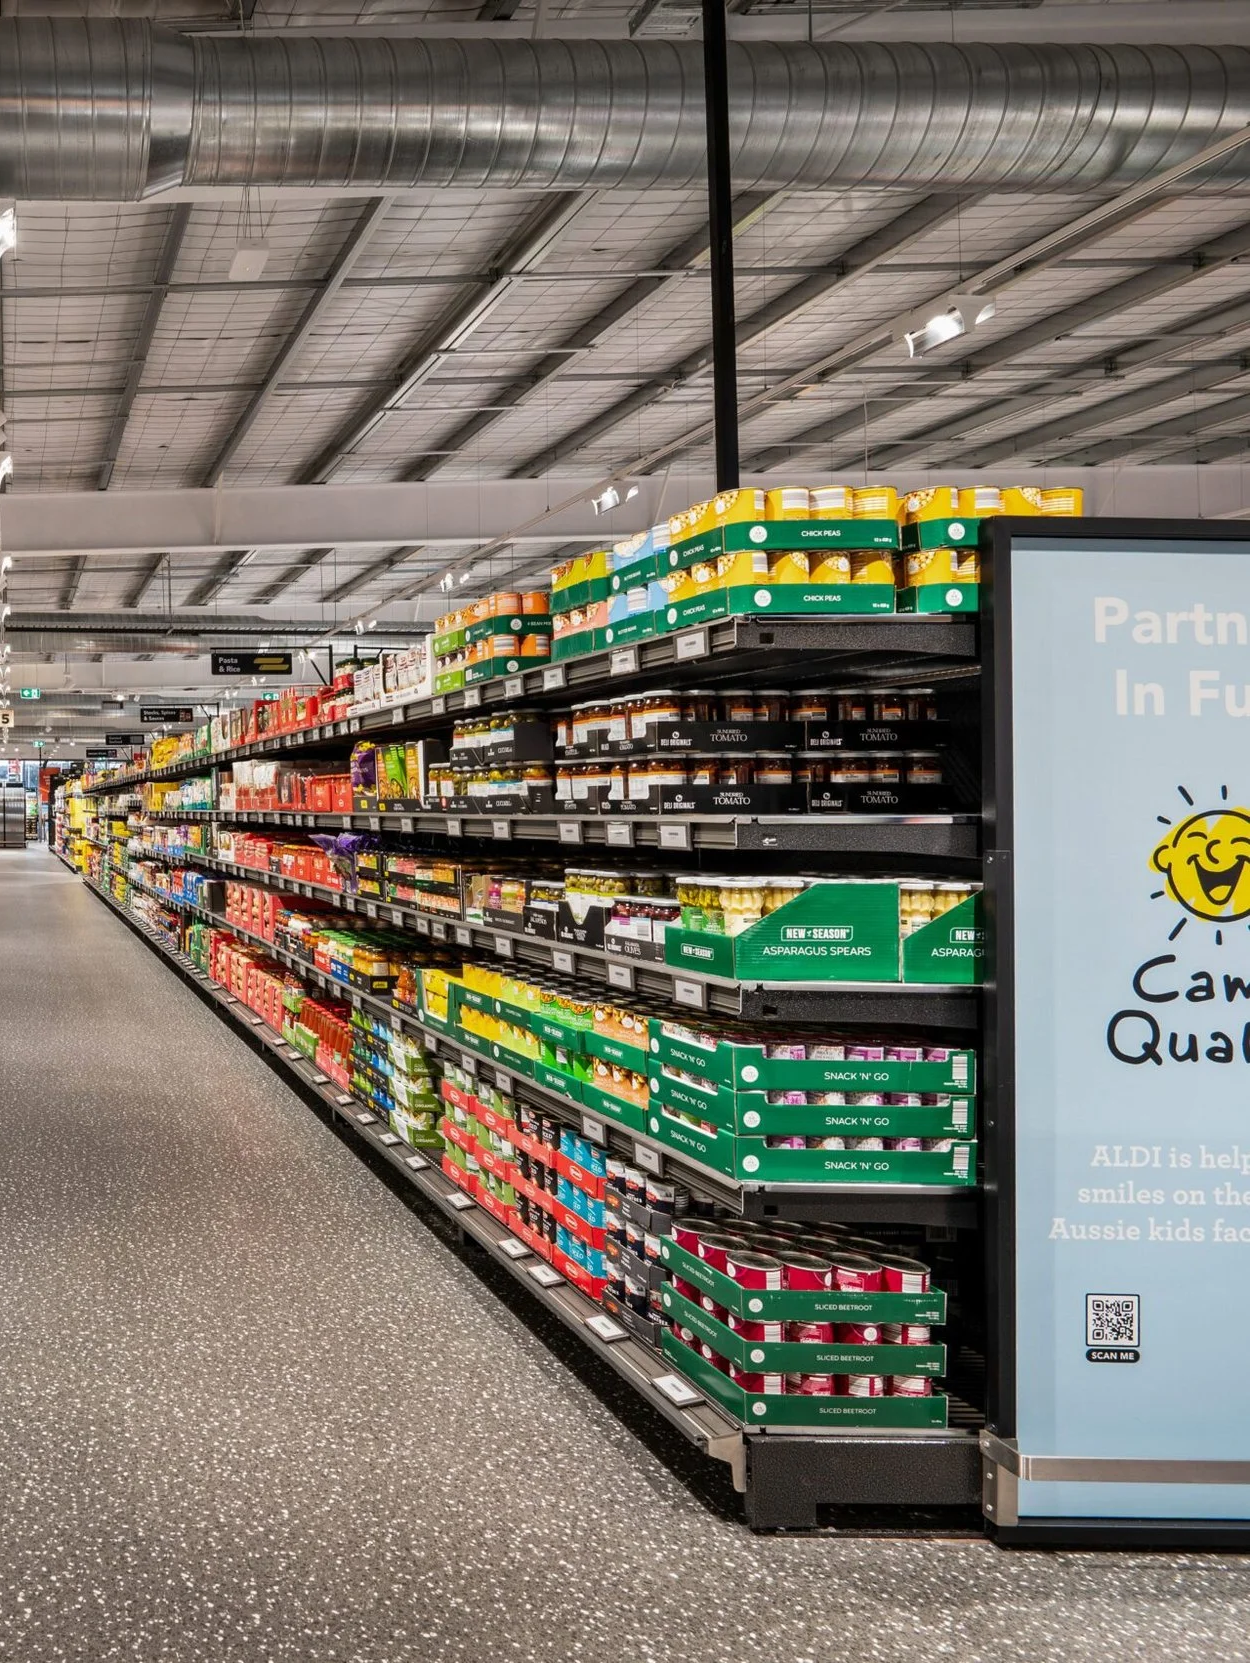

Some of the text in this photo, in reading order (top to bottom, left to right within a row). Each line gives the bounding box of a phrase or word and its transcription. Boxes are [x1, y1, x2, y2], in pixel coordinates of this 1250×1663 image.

[801, 529, 841, 537] CHICK PEAS
[803, 594, 841, 602] CHICK PEAS
[1093, 596, 1250, 645] Partn
[1115, 669, 1250, 717] In Fu
[1, 713, 9, 724] 5
[710, 734, 748, 742] TOMATO
[810, 738, 819, 746] DELI
[860, 733, 898, 741] TOMATO
[713, 797, 751, 805] TOMATO
[861, 796, 899, 804] TOMATO
[786, 929, 805, 939] NEW
[955, 930, 975, 941] NEW
[763, 946, 871, 956] ASPARAGUS SPEARS
[670, 1047, 689, 1061] SNACK
[696, 1057, 706, 1067] GO
[824, 1071, 889, 1081] SNACK 'N' GO
[670, 1088, 690, 1103] SNACK
[697, 1100, 707, 1110] GO
[825, 1116, 890, 1126] SNACK 'N' GO
[670, 1129, 690, 1144] SNACK
[696, 1141, 707, 1152] GO
[1090, 1145, 1162, 1169] ALDI
[1169, 1145, 1192, 1169] is
[824, 1161, 889, 1171] SNACK 'N' GO
[1078, 1183, 1250, 1206] smiles on the
[1048, 1217, 1250, 1242] Aussie kids fac
[814, 1303, 873, 1312] SLICED BEETROOT
[816, 1354, 874, 1362] SLICED BEETROOT
[1091, 1351, 1135, 1360] SCAN ME
